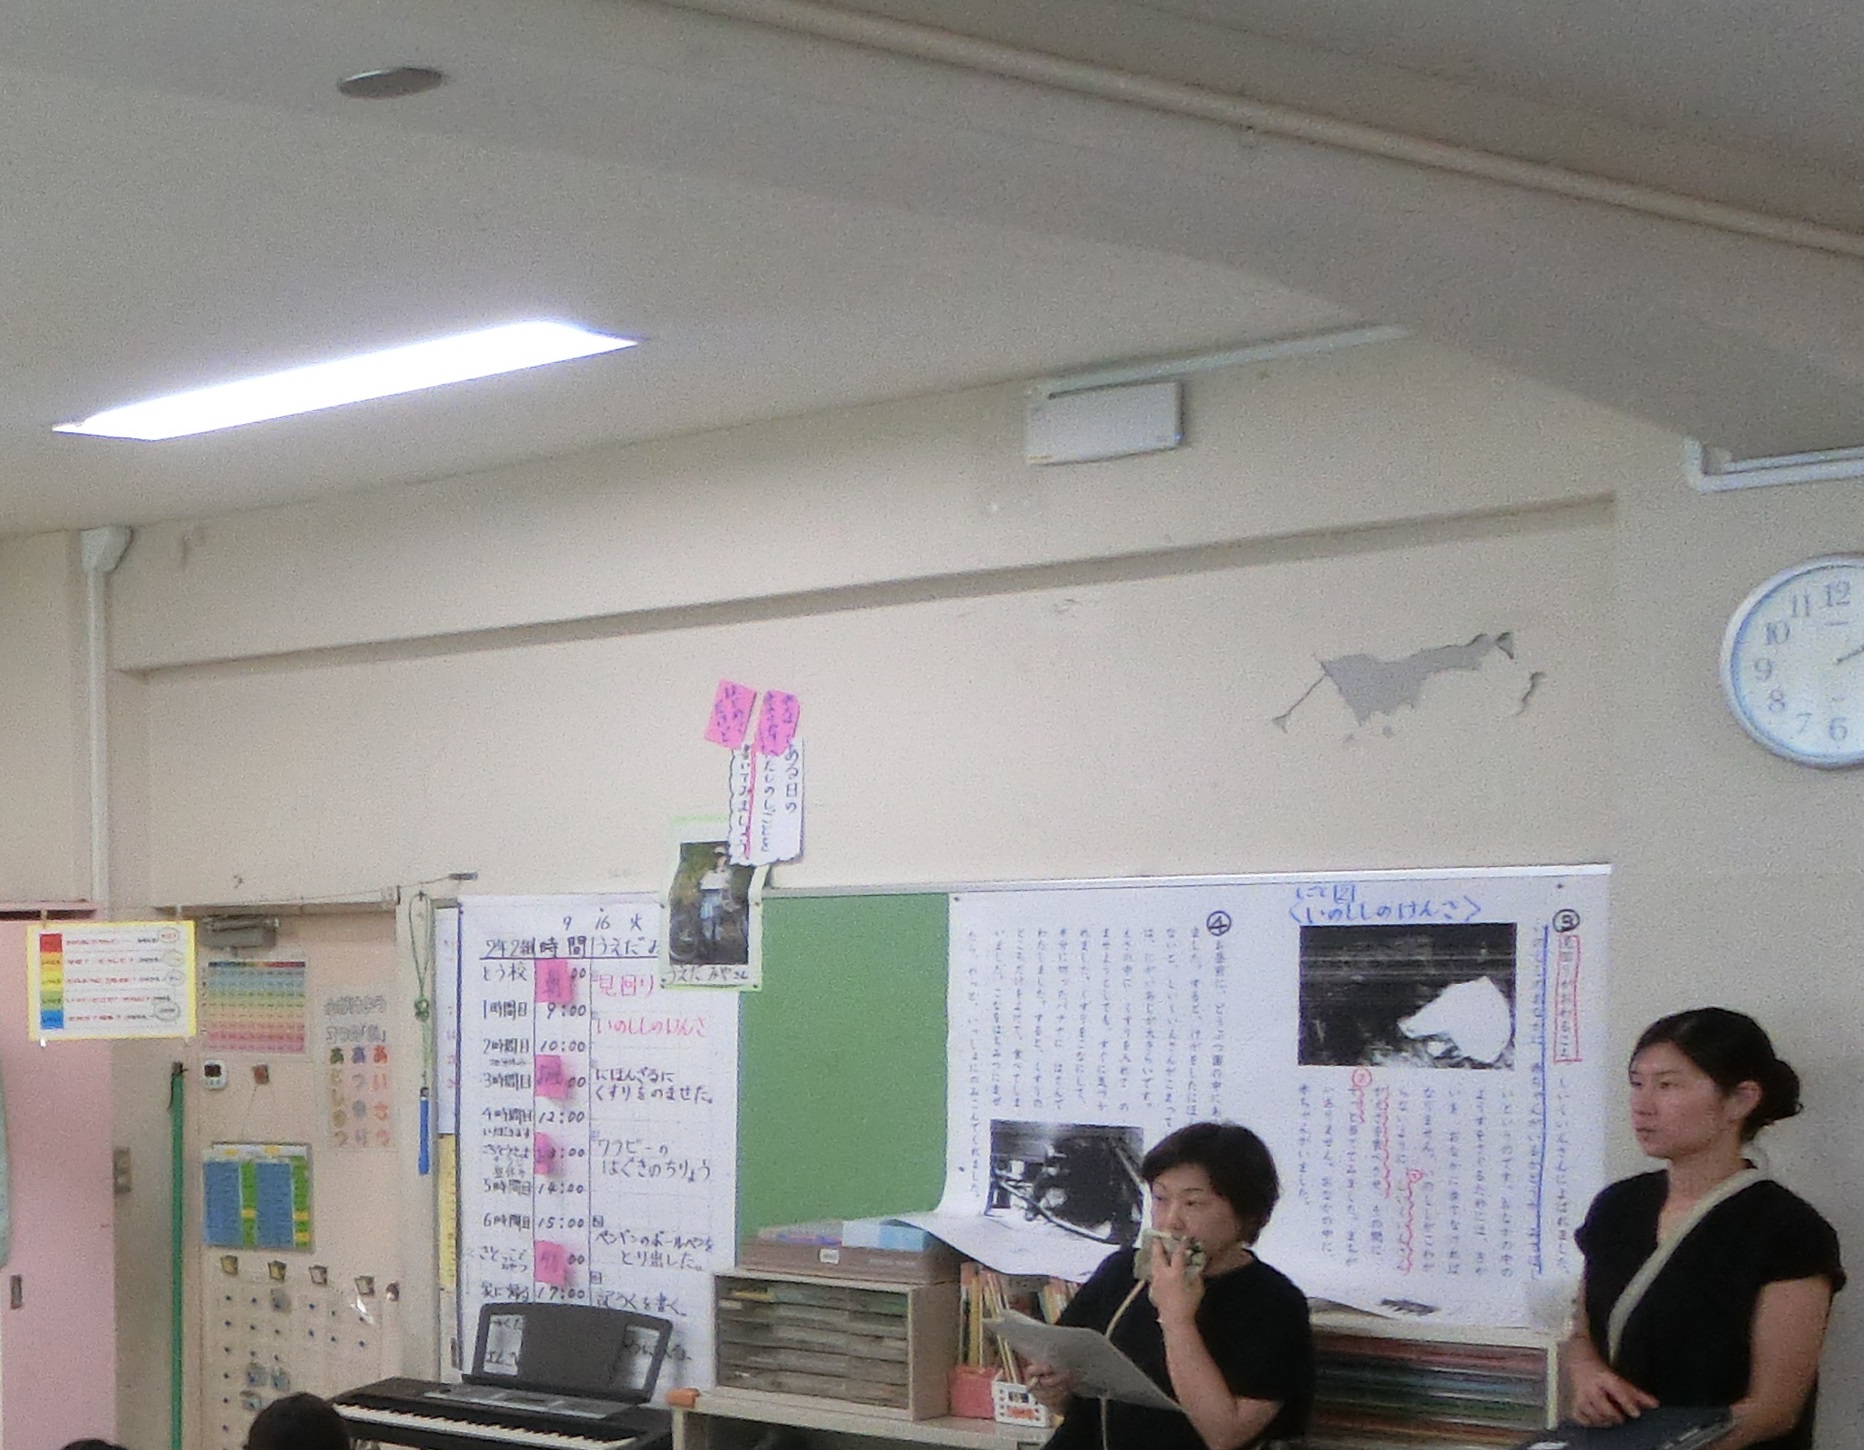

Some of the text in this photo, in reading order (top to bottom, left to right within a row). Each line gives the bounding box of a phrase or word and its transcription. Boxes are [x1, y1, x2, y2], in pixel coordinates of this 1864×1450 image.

[1791, 593, 1810, 618] 11
[1818, 580, 1851, 609] 12
[1766, 621, 1790, 646] 10
[1754, 657, 1772, 681] 9
[1768, 690, 1785, 714] 8
[1796, 712, 1812, 734] 7
[1829, 717, 1847, 741] 6
[547, 1002, 586, 1019] 9:00
[541, 1041, 586, 1052] 10:00
[539, 1111, 585, 1123] 12:00
[538, 1182, 584, 1194] 14:00
[538, 1217, 584, 1229] 15:00
